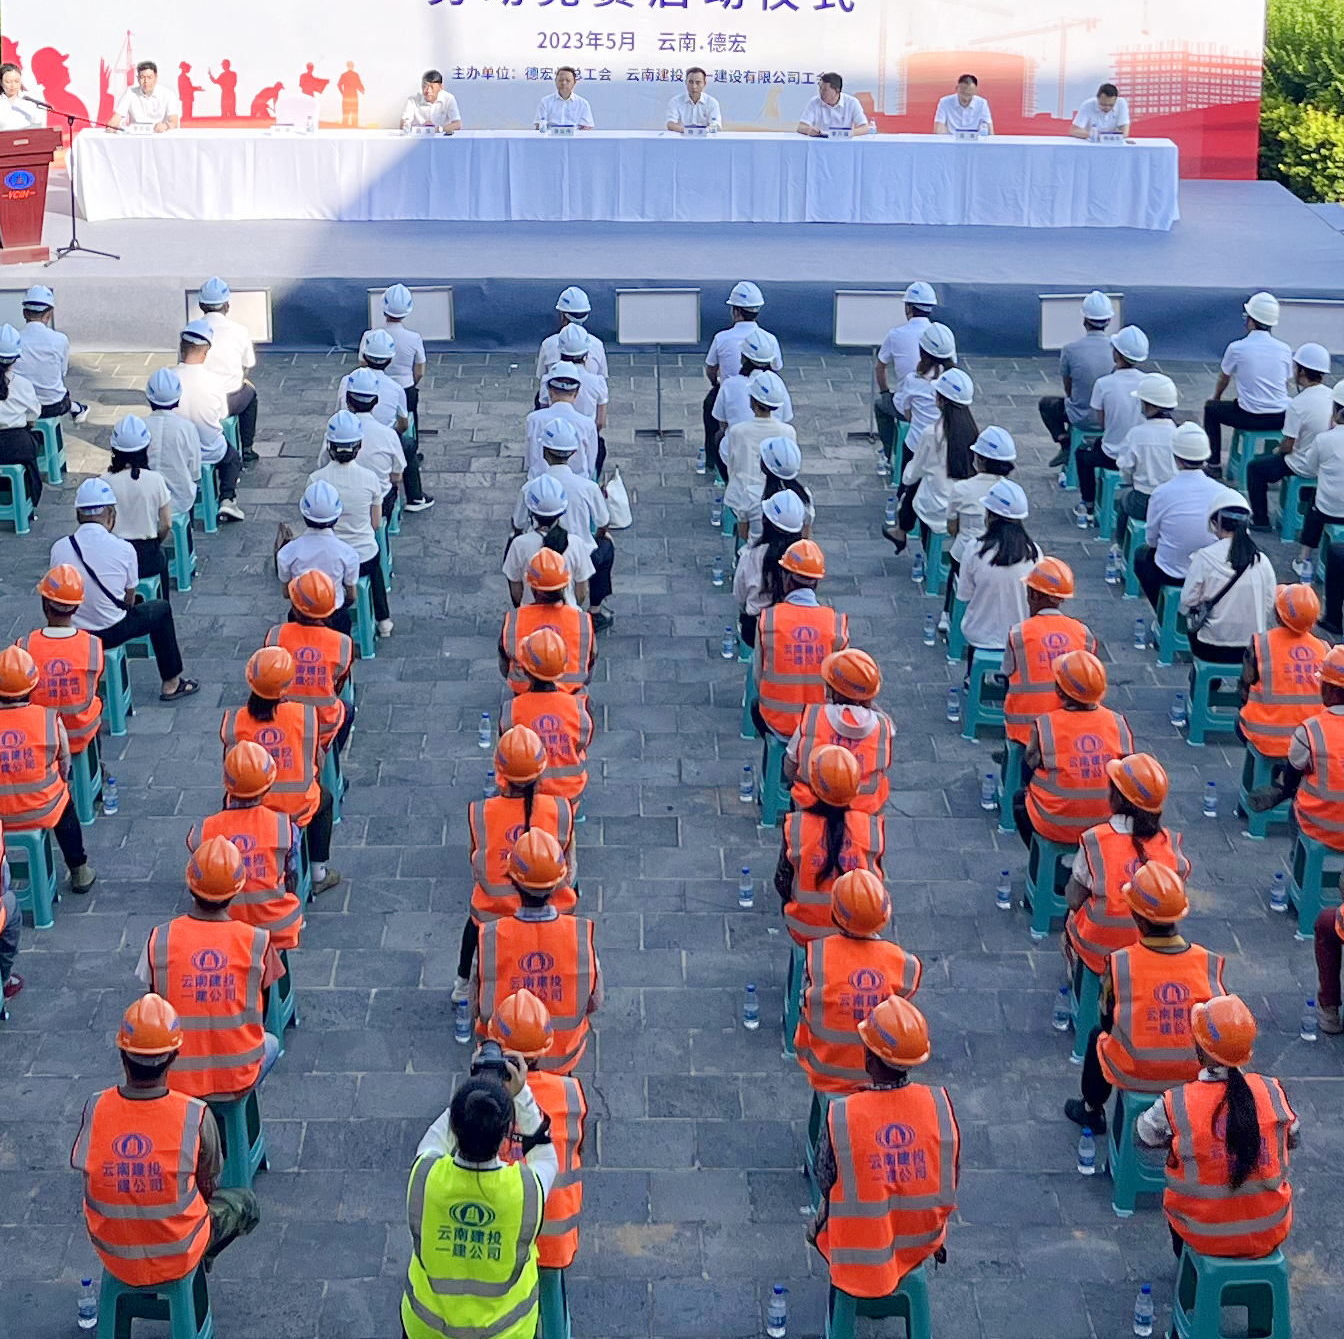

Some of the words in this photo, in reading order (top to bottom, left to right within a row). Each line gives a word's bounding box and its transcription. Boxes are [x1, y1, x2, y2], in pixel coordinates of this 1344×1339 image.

[537, 30, 637, 53] 2023年5月
[181, 974, 236, 988] 云南建投
[103, 1163, 163, 1178] 云南建投
[437, 1226, 502, 1245] 云南建投
[435, 1243, 501, 1262] 一建公司
